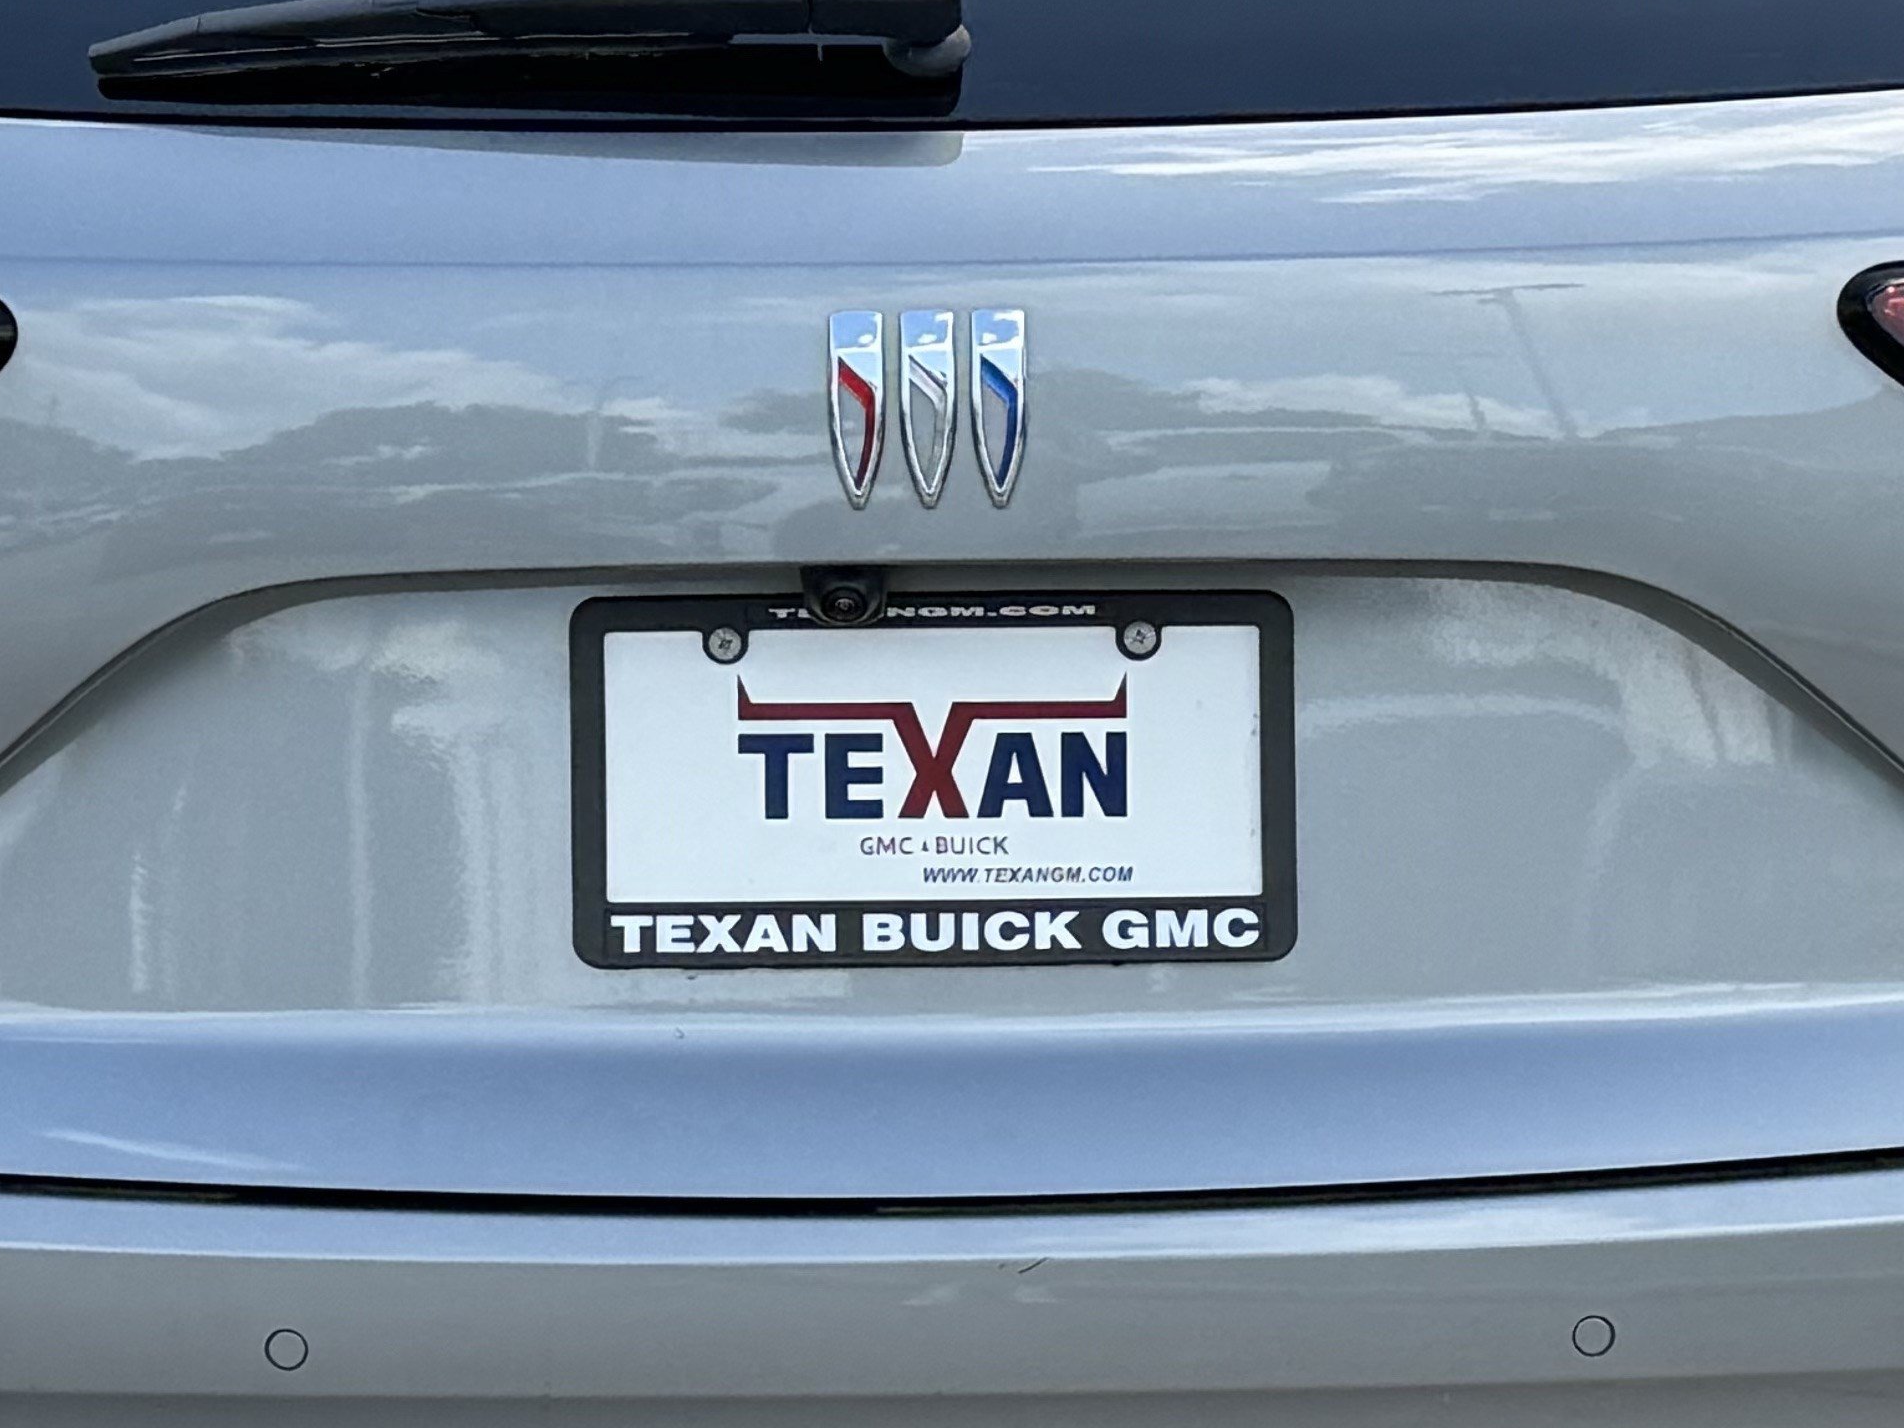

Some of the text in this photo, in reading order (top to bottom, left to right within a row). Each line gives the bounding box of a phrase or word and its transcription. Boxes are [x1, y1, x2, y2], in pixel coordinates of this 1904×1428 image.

[768, 605, 1096, 619] TNGM.COM
[737, 701, 1128, 820] TEXAN
[860, 835, 1010, 855] GMC BUICK
[922, 865, 1134, 883] WWW.TEXANGM.COM
[610, 908, 1261, 954] TEXAN BUICK GMC
